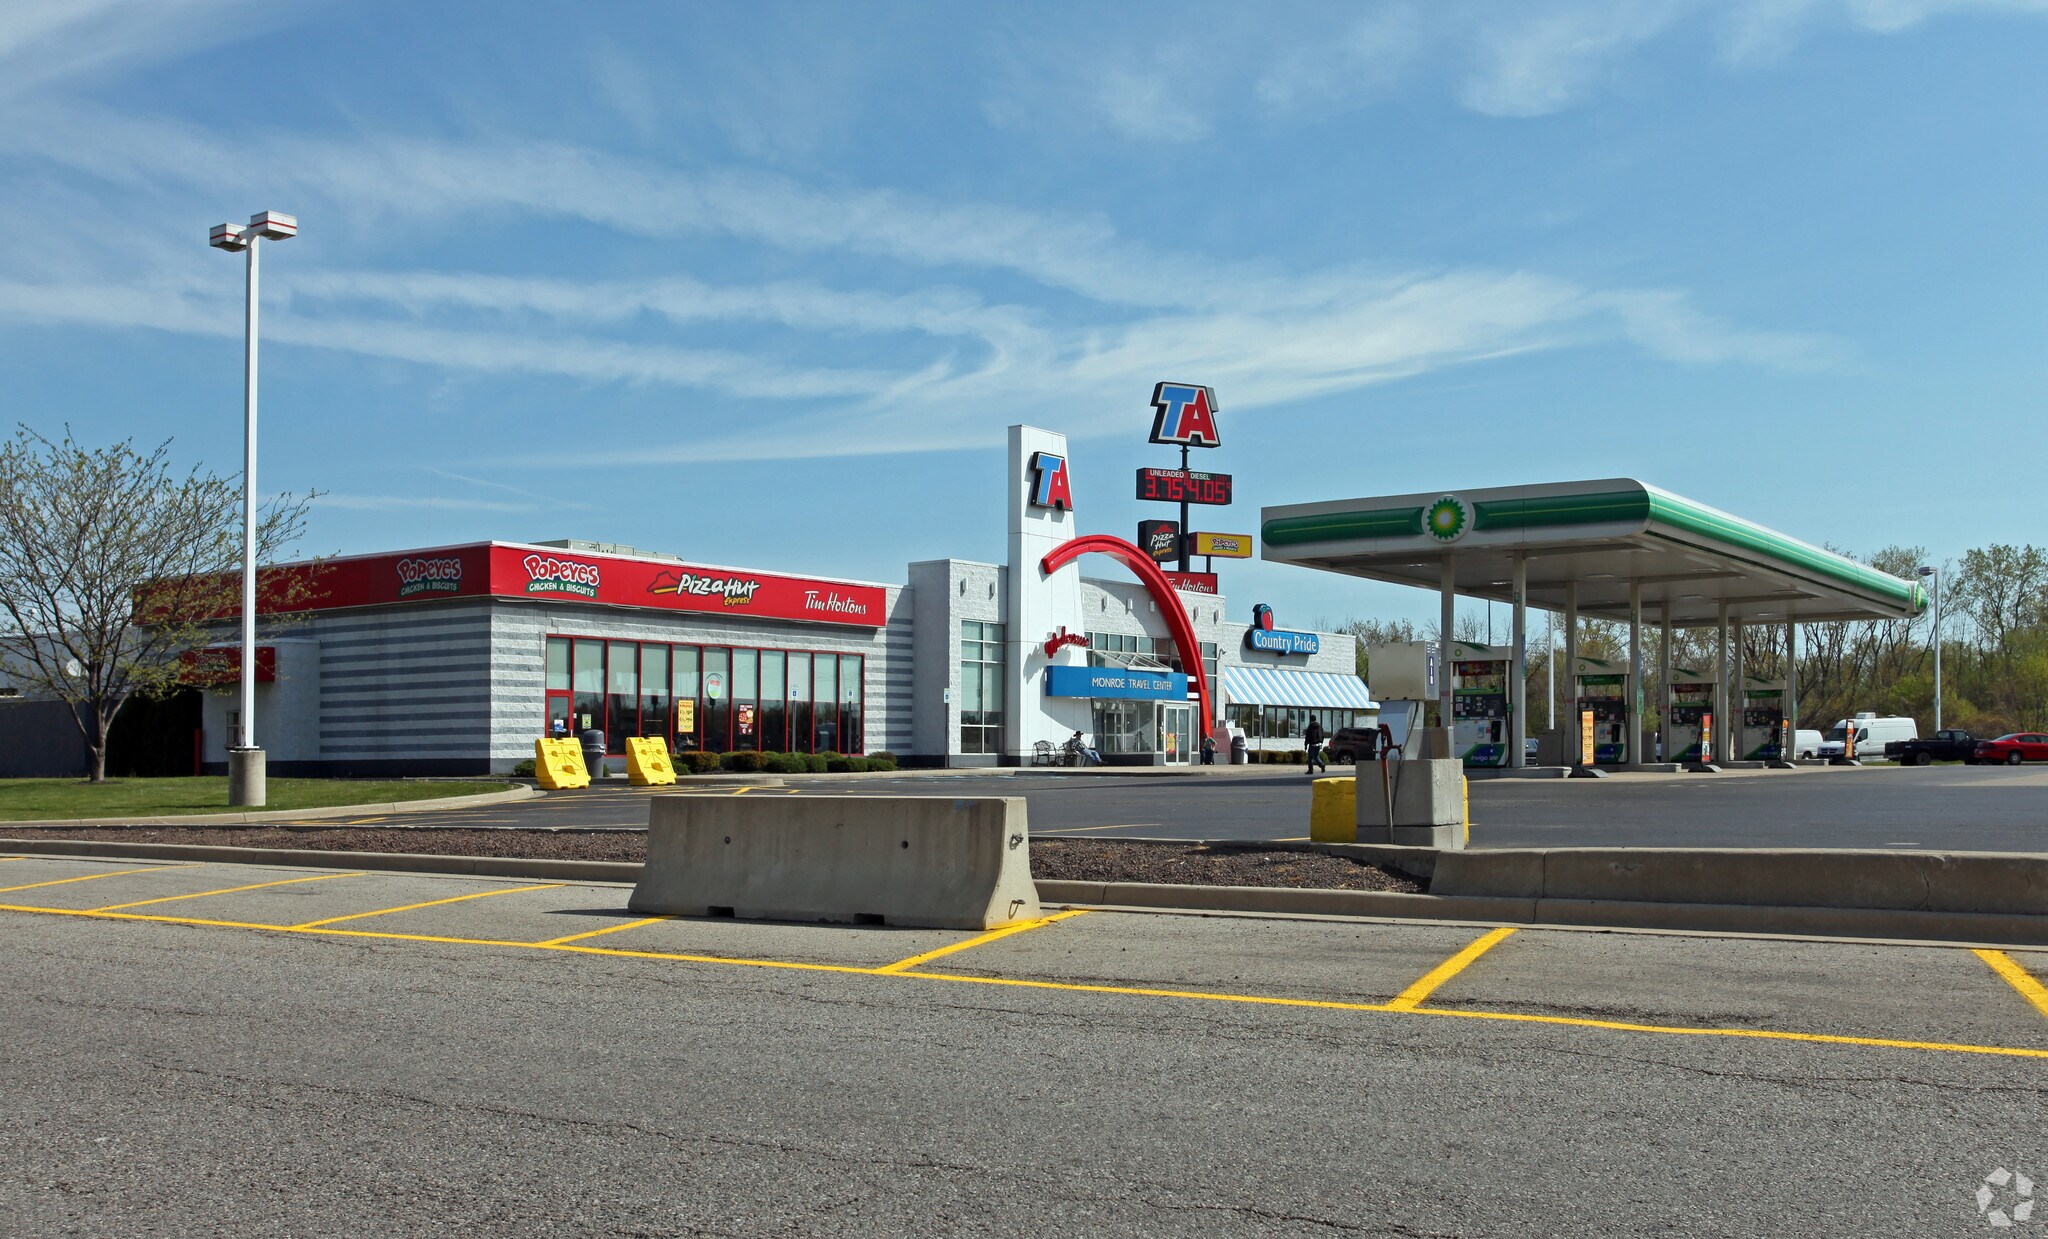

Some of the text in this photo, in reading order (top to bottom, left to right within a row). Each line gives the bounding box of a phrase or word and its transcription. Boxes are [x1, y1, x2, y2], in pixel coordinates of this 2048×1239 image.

[1157, 384, 1219, 445] TA
[1036, 453, 1072, 510] TA
[1149, 468, 1185, 479] UNLEADED
[1190, 472, 1211, 481] DIESEL
[1150, 532, 1175, 547] Pizza
[1154, 539, 1172, 550] Hut
[397, 558, 462, 583] Popeyes
[523, 553, 600, 587] Popeyes
[401, 583, 425, 596] CHICKEN
[431, 582, 458, 592] BISCUITS
[529, 582, 595, 597] CHICKEN & BISCUITS
[677, 573, 761, 599] Pizza Hut
[1180, 578, 1214, 593] Hortons
[804, 590, 867, 615] Tim Hortons
[1254, 631, 1317, 654] Country Pride
[1091, 677, 1173, 692] MONROE TRAVEL CENTER
